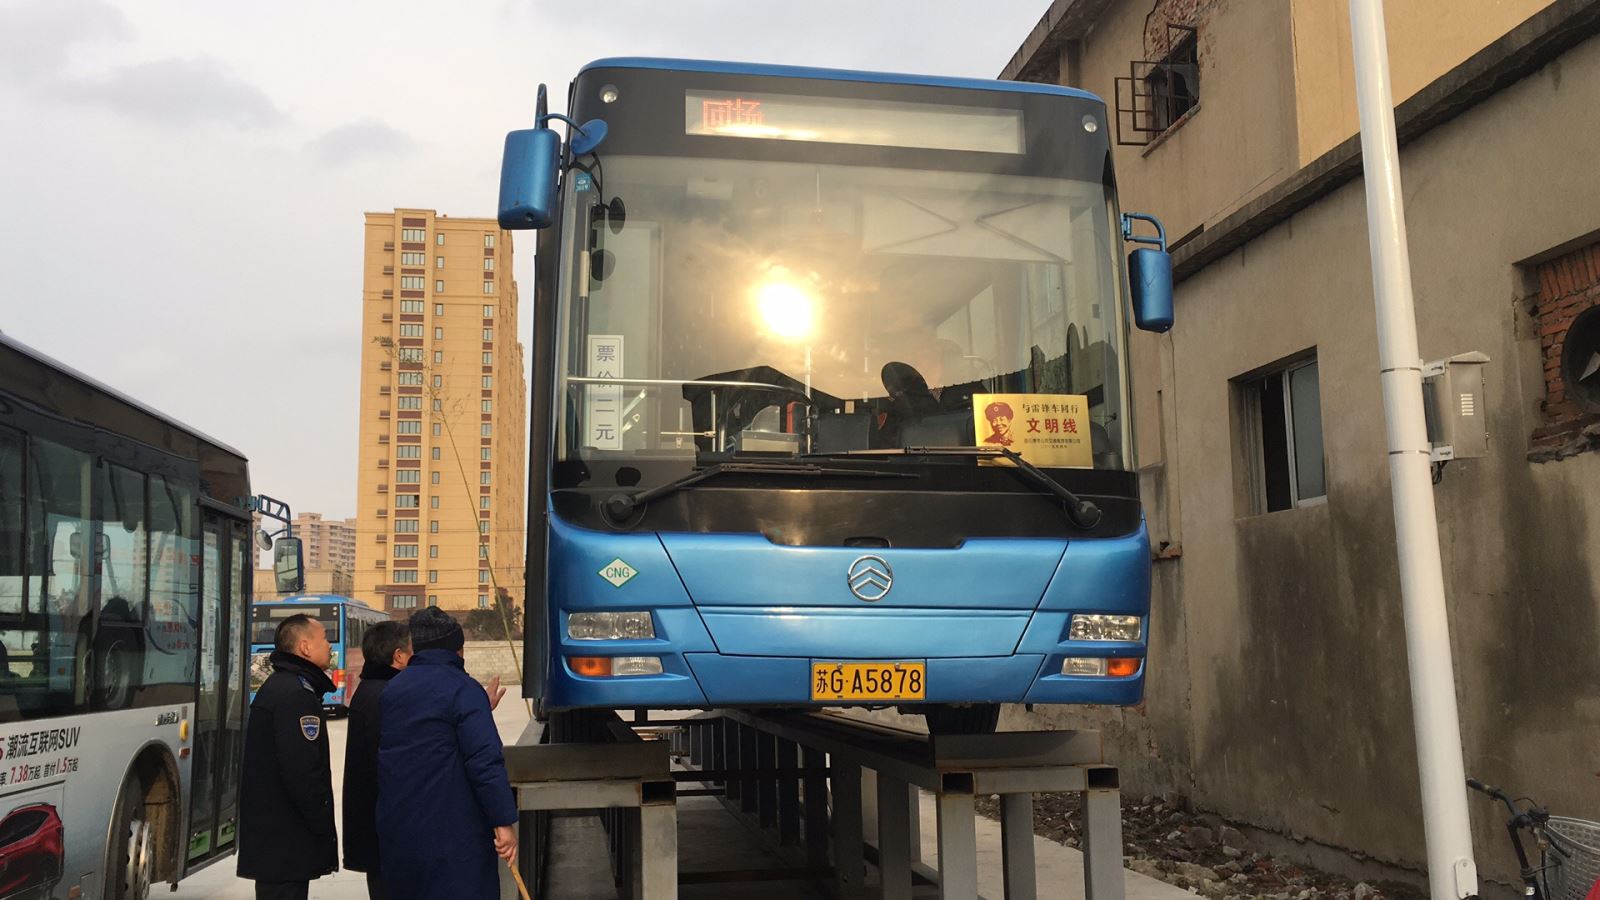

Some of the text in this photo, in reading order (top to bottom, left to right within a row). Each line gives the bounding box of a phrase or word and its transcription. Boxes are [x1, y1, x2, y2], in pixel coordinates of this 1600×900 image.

[1026, 417, 1078, 434] 文明线
[605, 566, 630, 578] CNG
